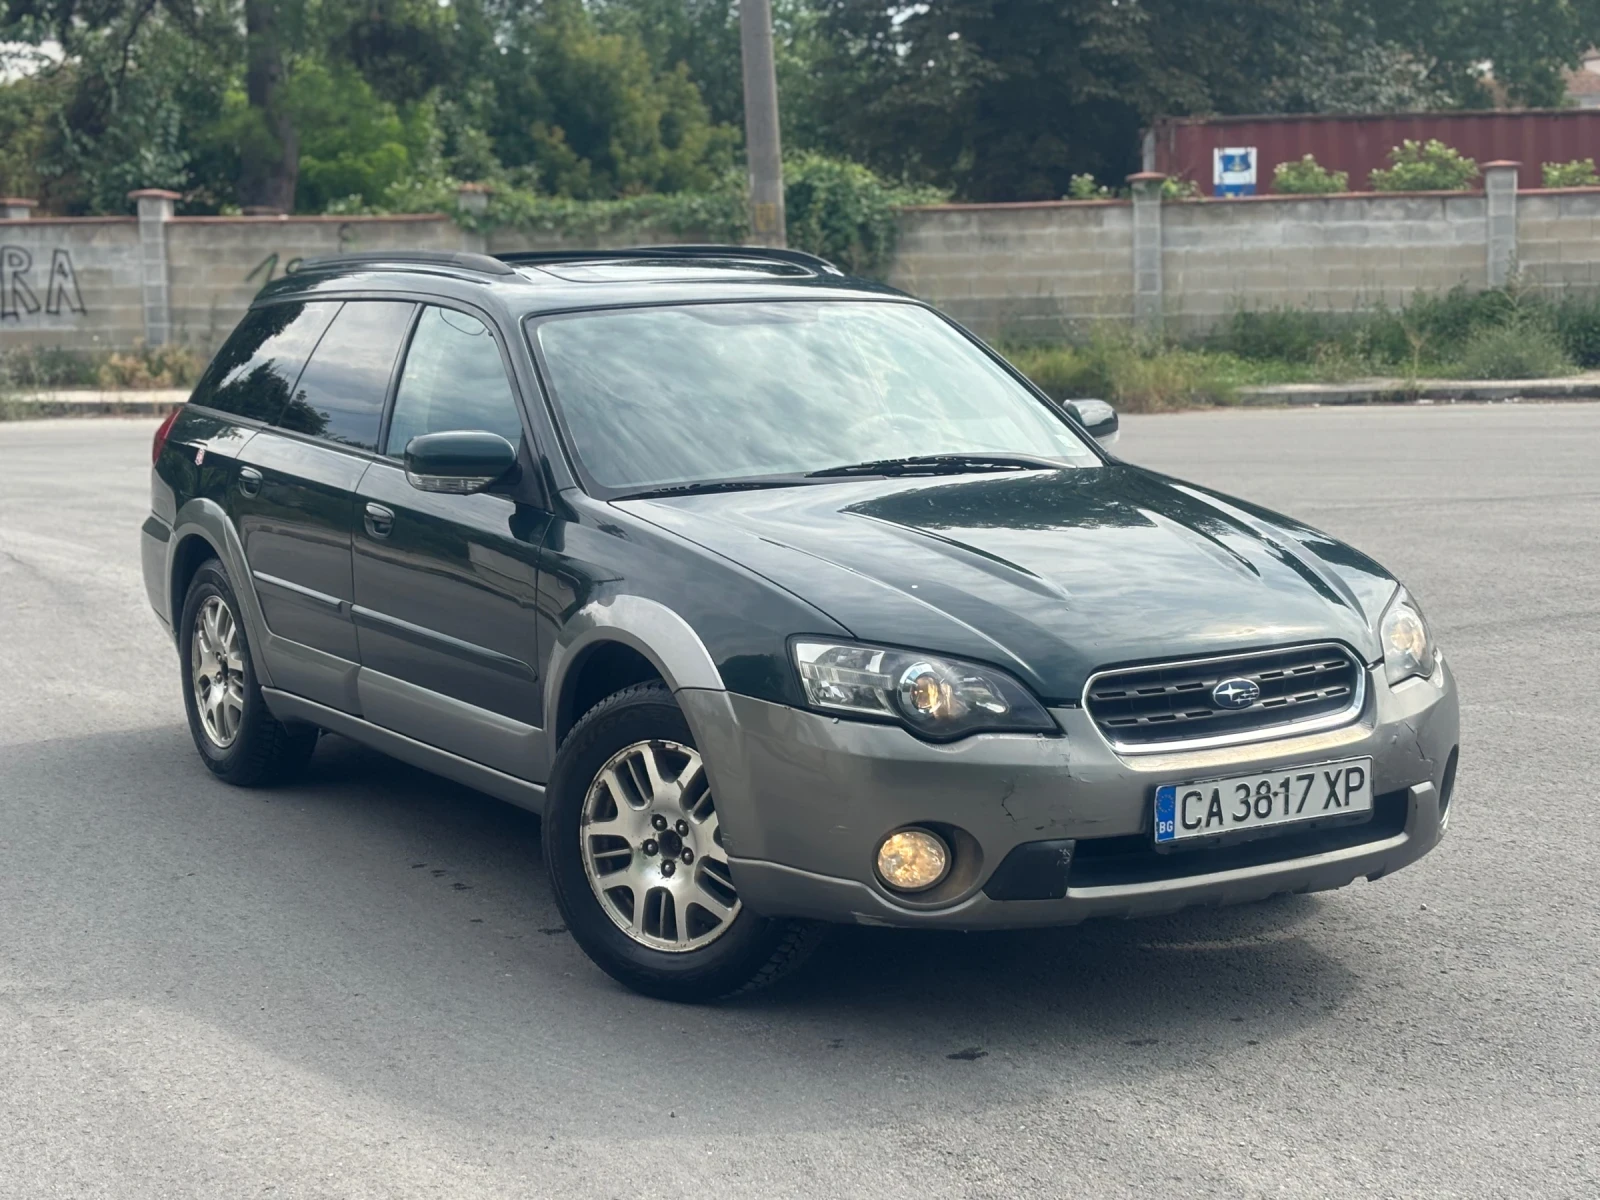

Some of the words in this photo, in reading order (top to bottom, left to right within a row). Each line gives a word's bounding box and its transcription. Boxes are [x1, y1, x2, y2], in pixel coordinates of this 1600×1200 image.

[1181, 787, 1224, 830] CA
[1232, 773, 1315, 822] 3817
[1322, 766, 1365, 810] XP
[1158, 820, 1174, 834] BG
